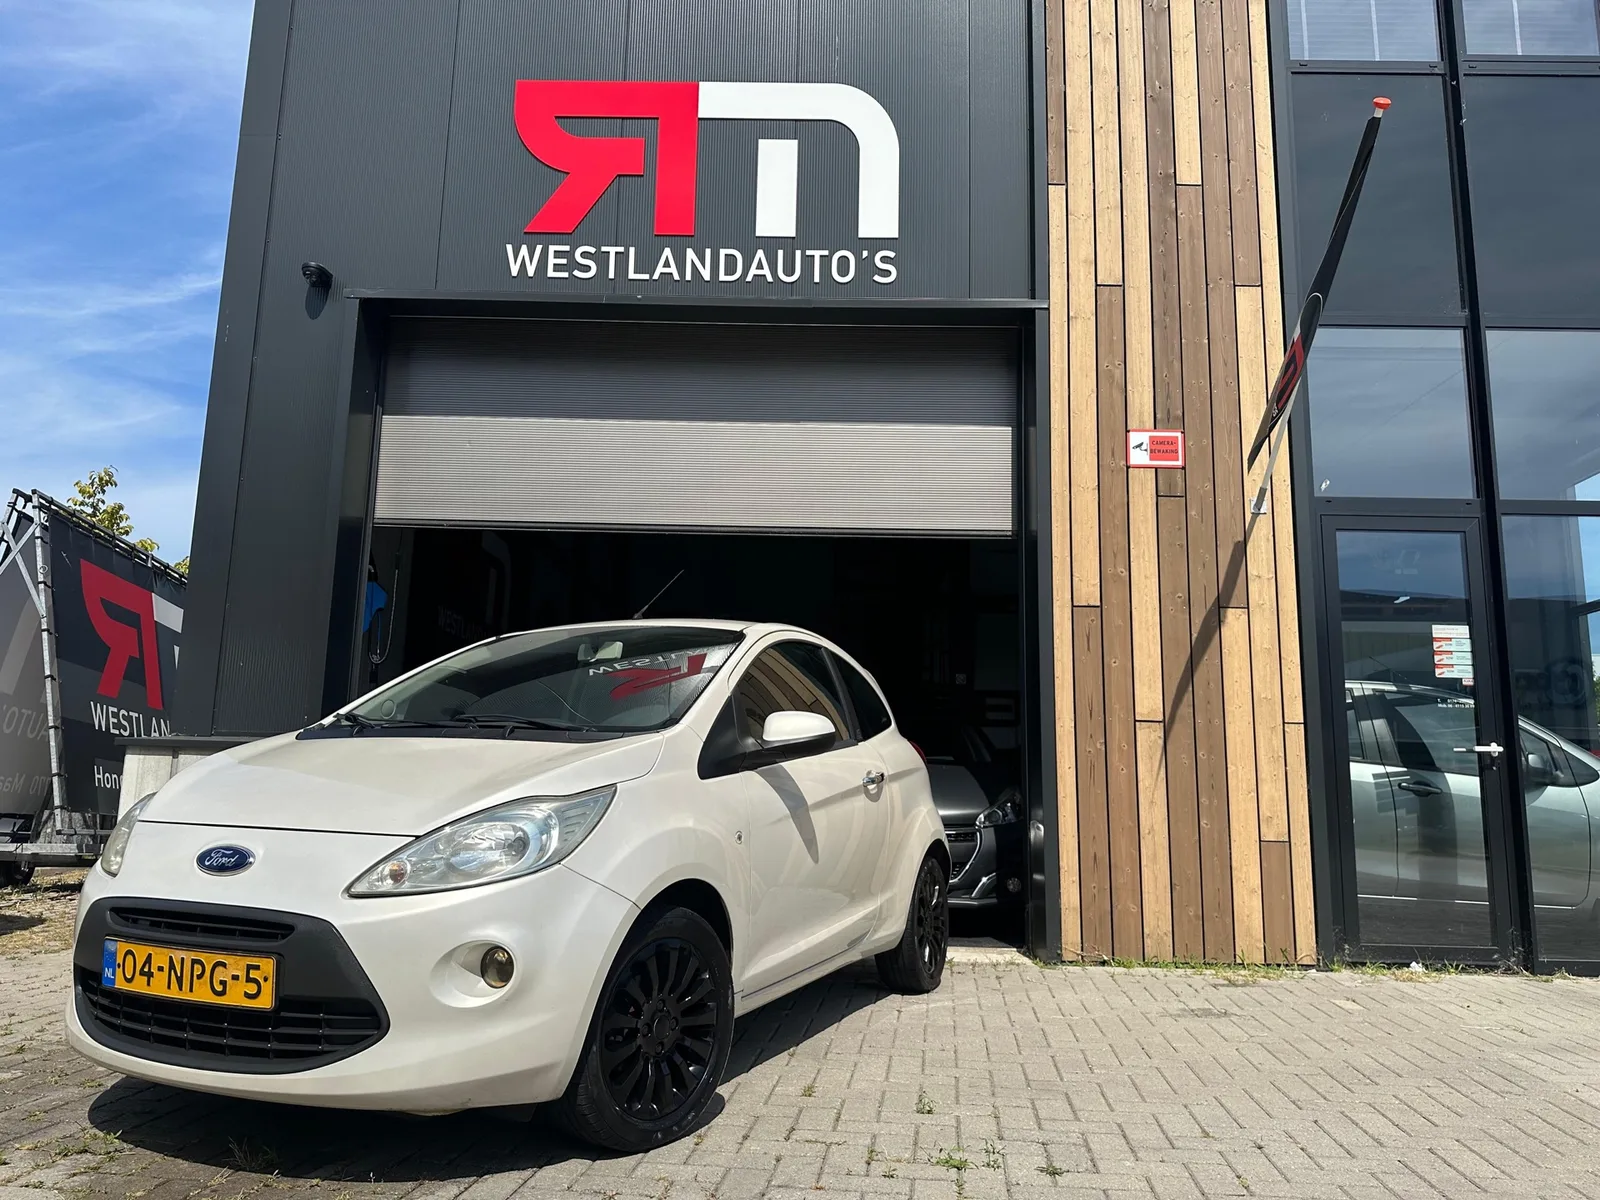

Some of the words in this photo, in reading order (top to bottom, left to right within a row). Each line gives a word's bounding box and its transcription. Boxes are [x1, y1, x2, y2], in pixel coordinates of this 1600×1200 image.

[505, 243, 898, 284] WESTLANDAUTO'S
[94, 765, 123, 790] Hon
[204, 848, 240, 867] Ford
[104, 967, 115, 980] NL
[121, 948, 263, 1000] 04-NPG-5
